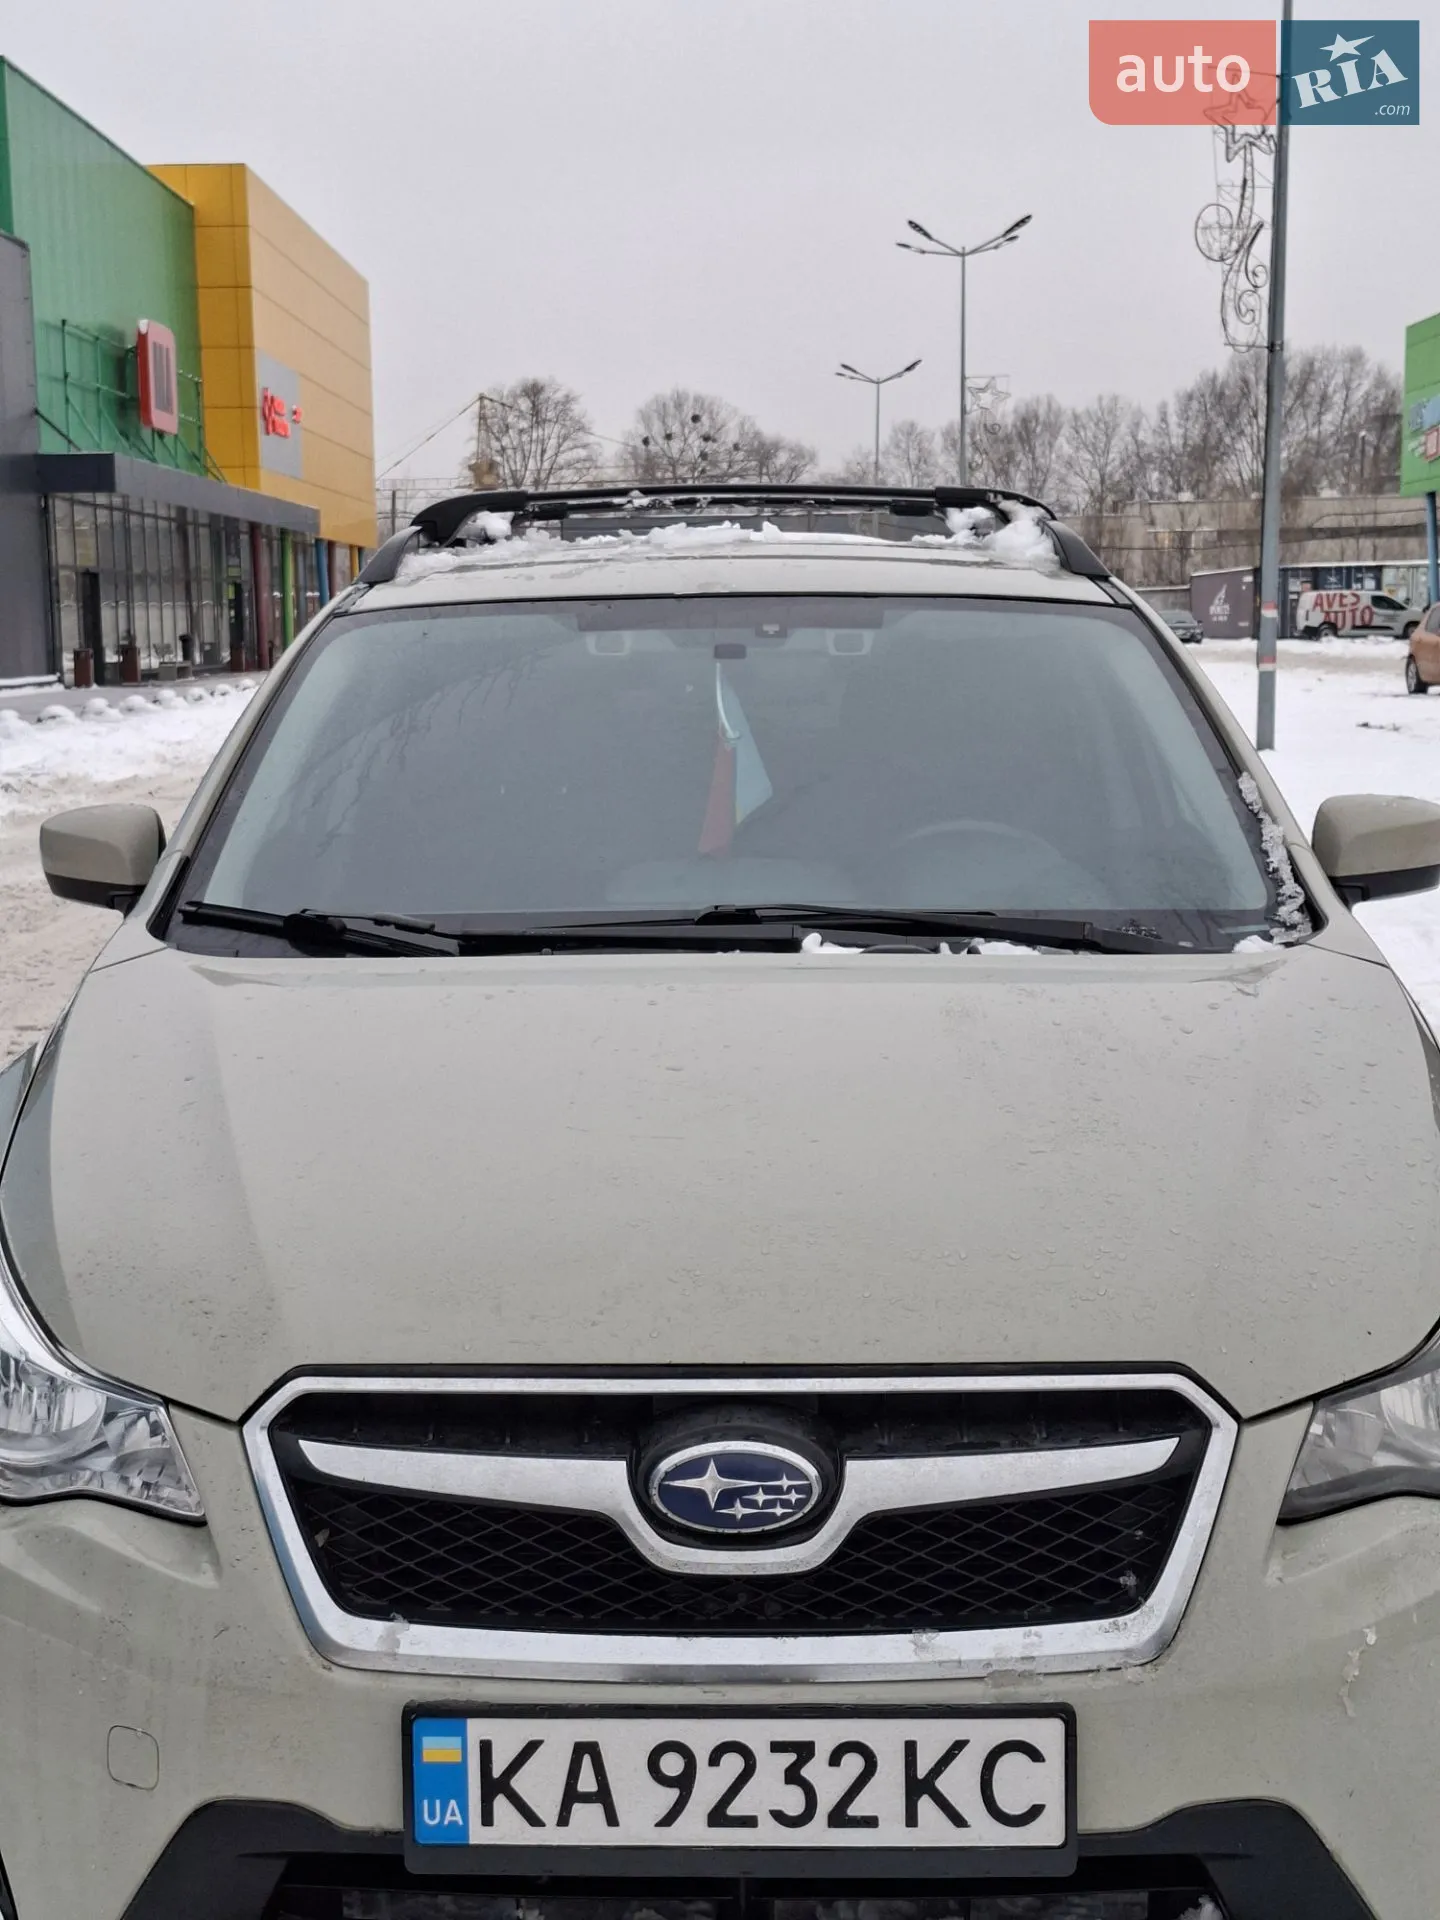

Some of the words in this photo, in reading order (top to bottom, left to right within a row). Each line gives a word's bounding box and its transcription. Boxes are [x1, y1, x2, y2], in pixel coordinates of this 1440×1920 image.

[1312, 591, 1361, 613] AVES
[1323, 605, 1374, 631] AUTO
[479, 1739, 620, 1829] KA
[646, 1739, 880, 1829] 9232
[904, 1739, 1046, 1829] KC
[423, 1799, 463, 1826] UA
